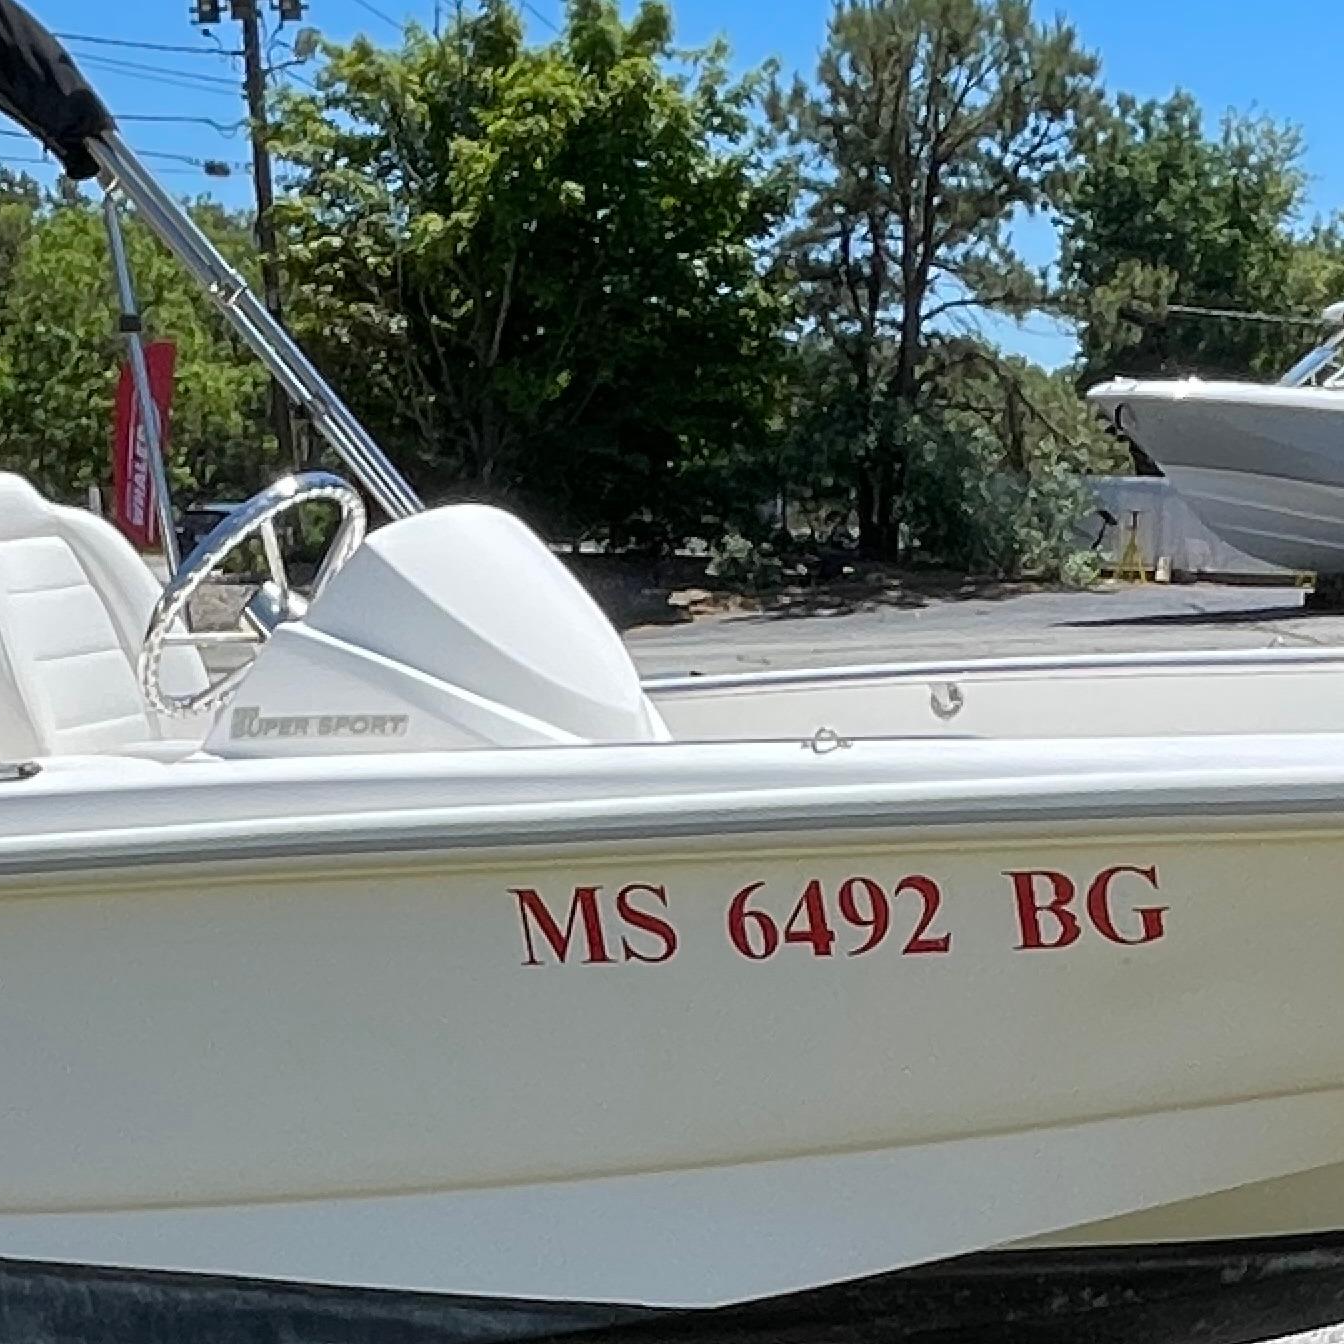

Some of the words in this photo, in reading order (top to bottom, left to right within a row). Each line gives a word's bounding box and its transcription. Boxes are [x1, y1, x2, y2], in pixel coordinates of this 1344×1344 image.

[318, 714, 409, 736] SPORT
[507, 883, 678, 966] MS
[727, 874, 952, 960] 6492
[1002, 864, 1170, 951] BG
